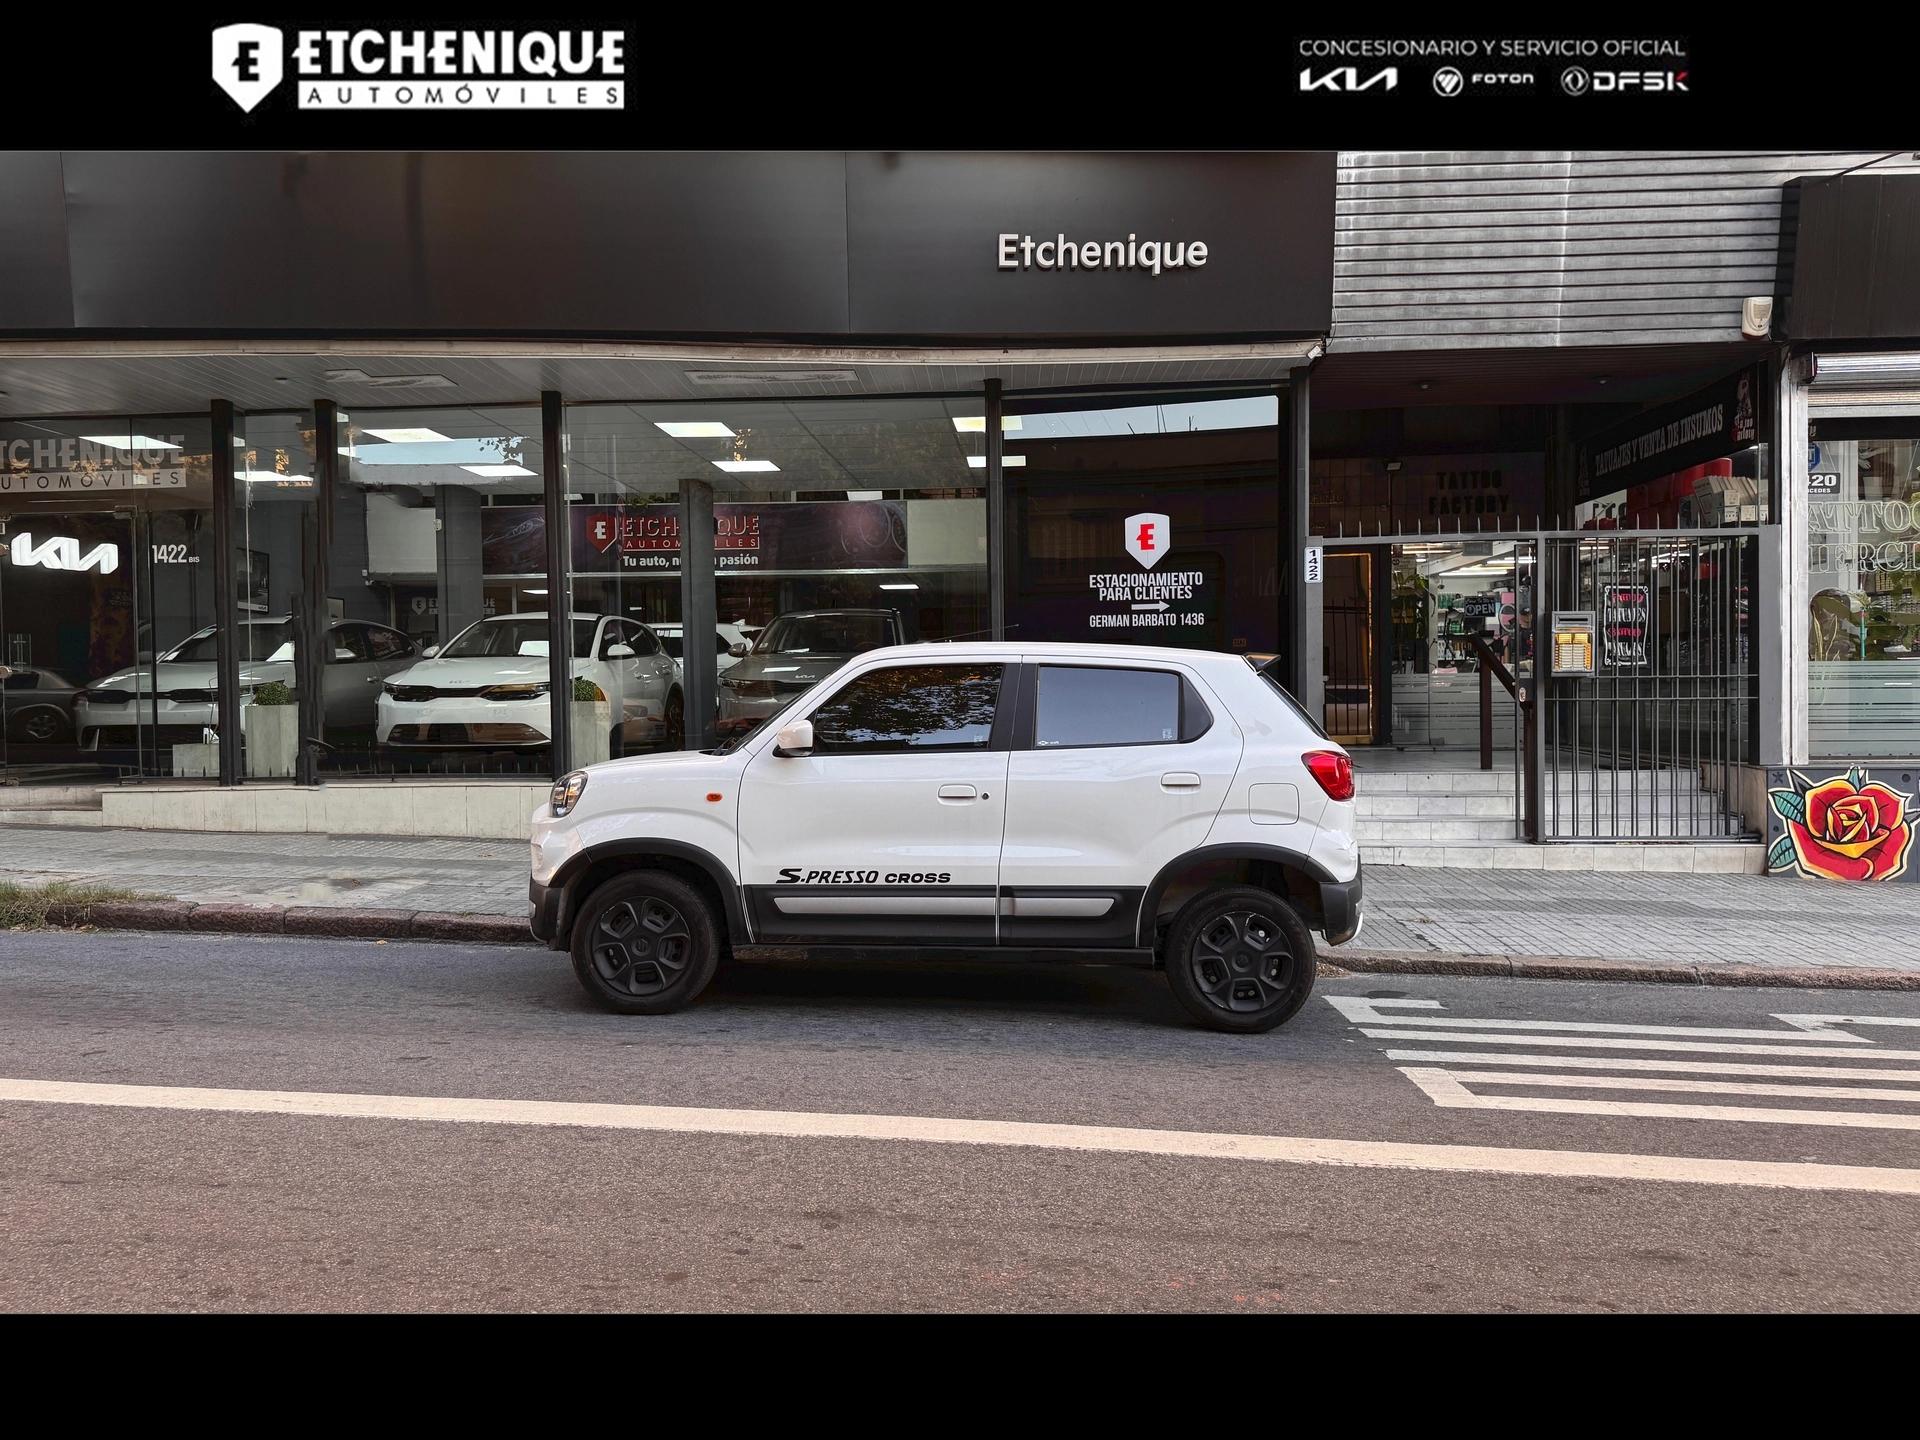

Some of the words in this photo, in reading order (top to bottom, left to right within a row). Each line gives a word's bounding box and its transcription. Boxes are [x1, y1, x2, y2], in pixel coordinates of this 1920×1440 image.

[998, 233, 1209, 276] Etchenique
[1638, 427, 1666, 460] VENTA
[1667, 421, 1679, 448] DE
[1680, 404, 1723, 444] INSUMOS
[0, 435, 185, 470] TCHENIQUE
[1438, 469, 1501, 490] TATTOO
[1808, 474, 1837, 487] 20
[1428, 494, 1510, 516] FACTORY
[1808, 500, 1920, 533] ATTO
[151, 544, 187, 564] 1422
[623, 556, 637, 566] Tu
[640, 556, 669, 568] auto,
[720, 554, 759, 567] pasión
[1308, 549, 1319, 581] 1422
[1089, 571, 1203, 588] ESTACIONAMIENTO
[1099, 587, 1132, 601] PARA
[1135, 585, 1193, 600] CLIENTES
[1465, 603, 1495, 616] OPEN
[1089, 614, 1130, 628] GERMAN
[1132, 613, 1177, 627] BARBATO
[1180, 612, 1205, 626] 1436
[884, 872, 951, 884] CROSS
